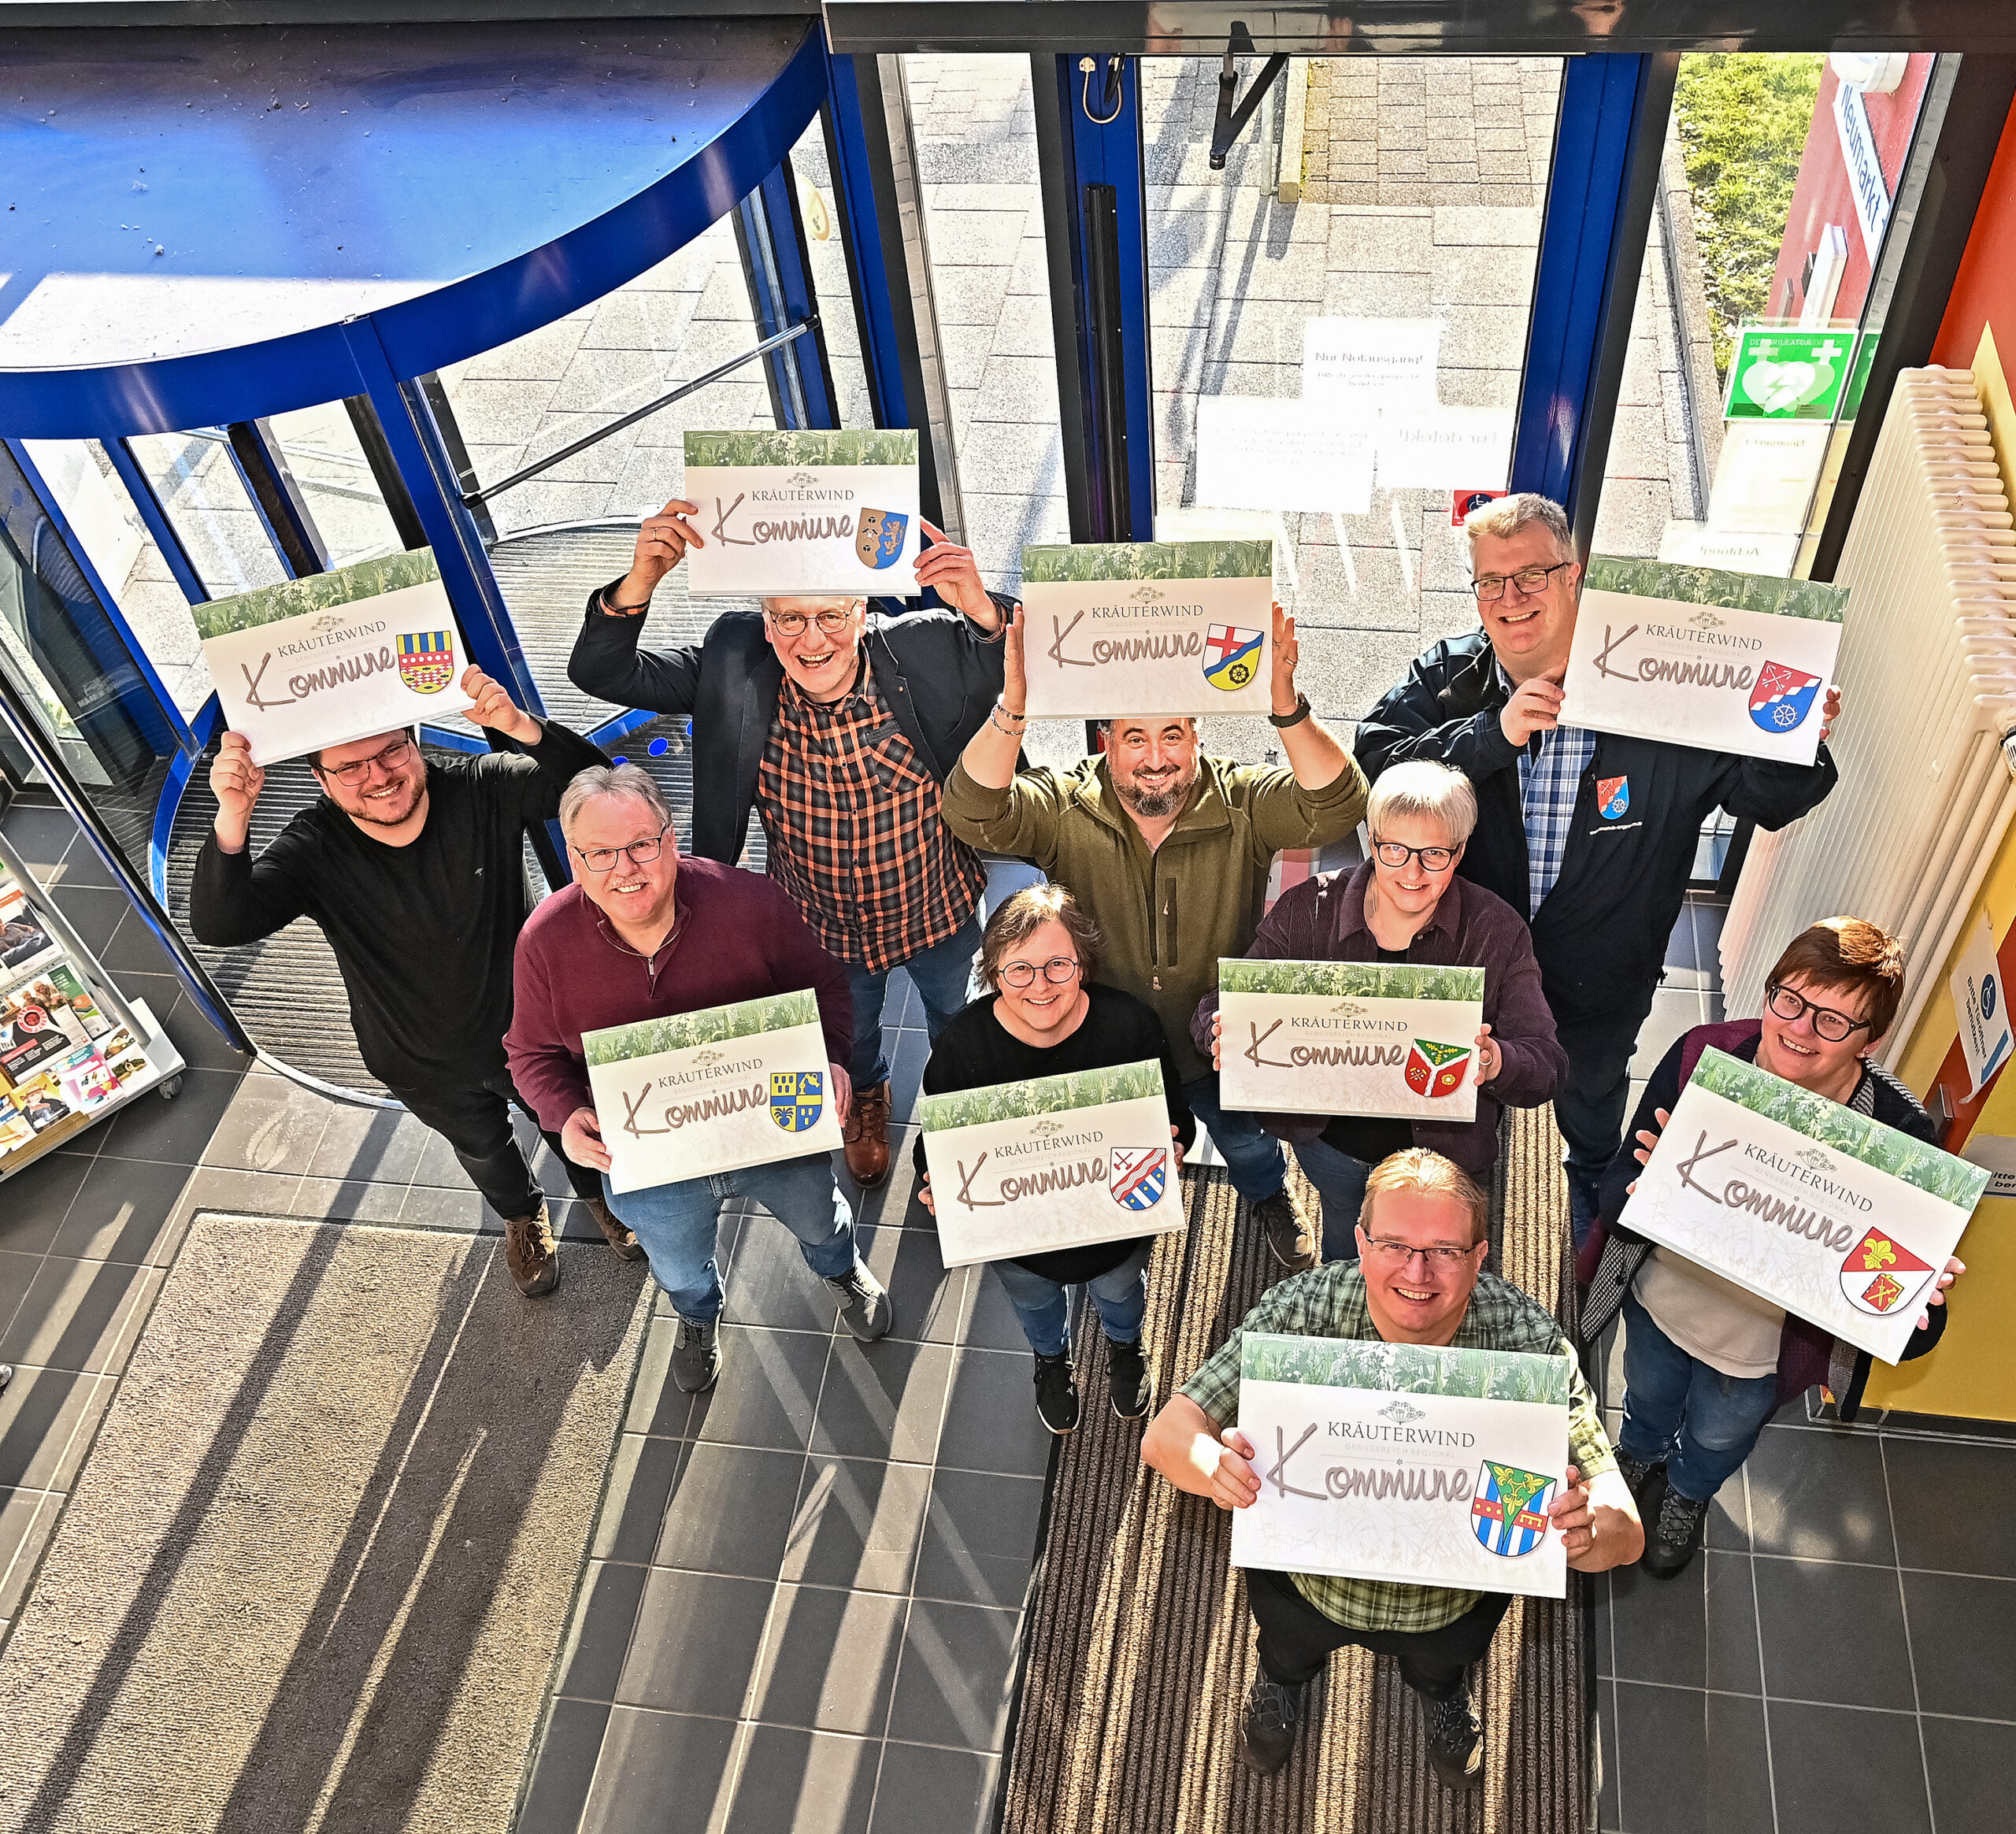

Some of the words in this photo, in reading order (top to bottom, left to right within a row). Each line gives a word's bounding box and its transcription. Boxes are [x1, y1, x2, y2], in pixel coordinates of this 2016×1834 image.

[1841, 84, 1881, 233] Neumarkt
[711, 492, 854, 546] Kommune
[752, 488, 854, 502] KRÄUTERWIND
[1092, 605, 1203, 618] KRÄUTERWIND
[1646, 624, 1762, 650] KRÄUTERWIND
[277, 621, 387, 658] KRÄUTERWIND
[1047, 609, 1203, 668] Kommune
[1592, 624, 1755, 690] Kommune
[241, 647, 395, 712] Kommune
[1243, 1018, 1405, 1069] Kommune
[1292, 1016, 1408, 1032] KRÄUTERWIND
[1966, 998, 1980, 1056] benutzen!
[658, 1058, 763, 1088] KRÄUTERWIND
[623, 1082, 769, 1139] Kommune
[995, 1130, 1103, 1158] KRÄUTERWIND
[957, 1151, 1108, 1211] Kommune
[1676, 1129, 1855, 1253] Kommune
[1744, 1143, 1873, 1213] KRÄUTERWIND
[1754, 1165, 1807, 1199] GENUSSREICH
[1809, 1192, 1848, 1216] REGIONAL
[1328, 1421, 1475, 1448] KRÄUTERWIND
[1344, 1442, 1408, 1455] GENUSSREICH
[1410, 1447, 1455, 1459] REGIONAL
[1266, 1421, 1473, 1502] Kommune
